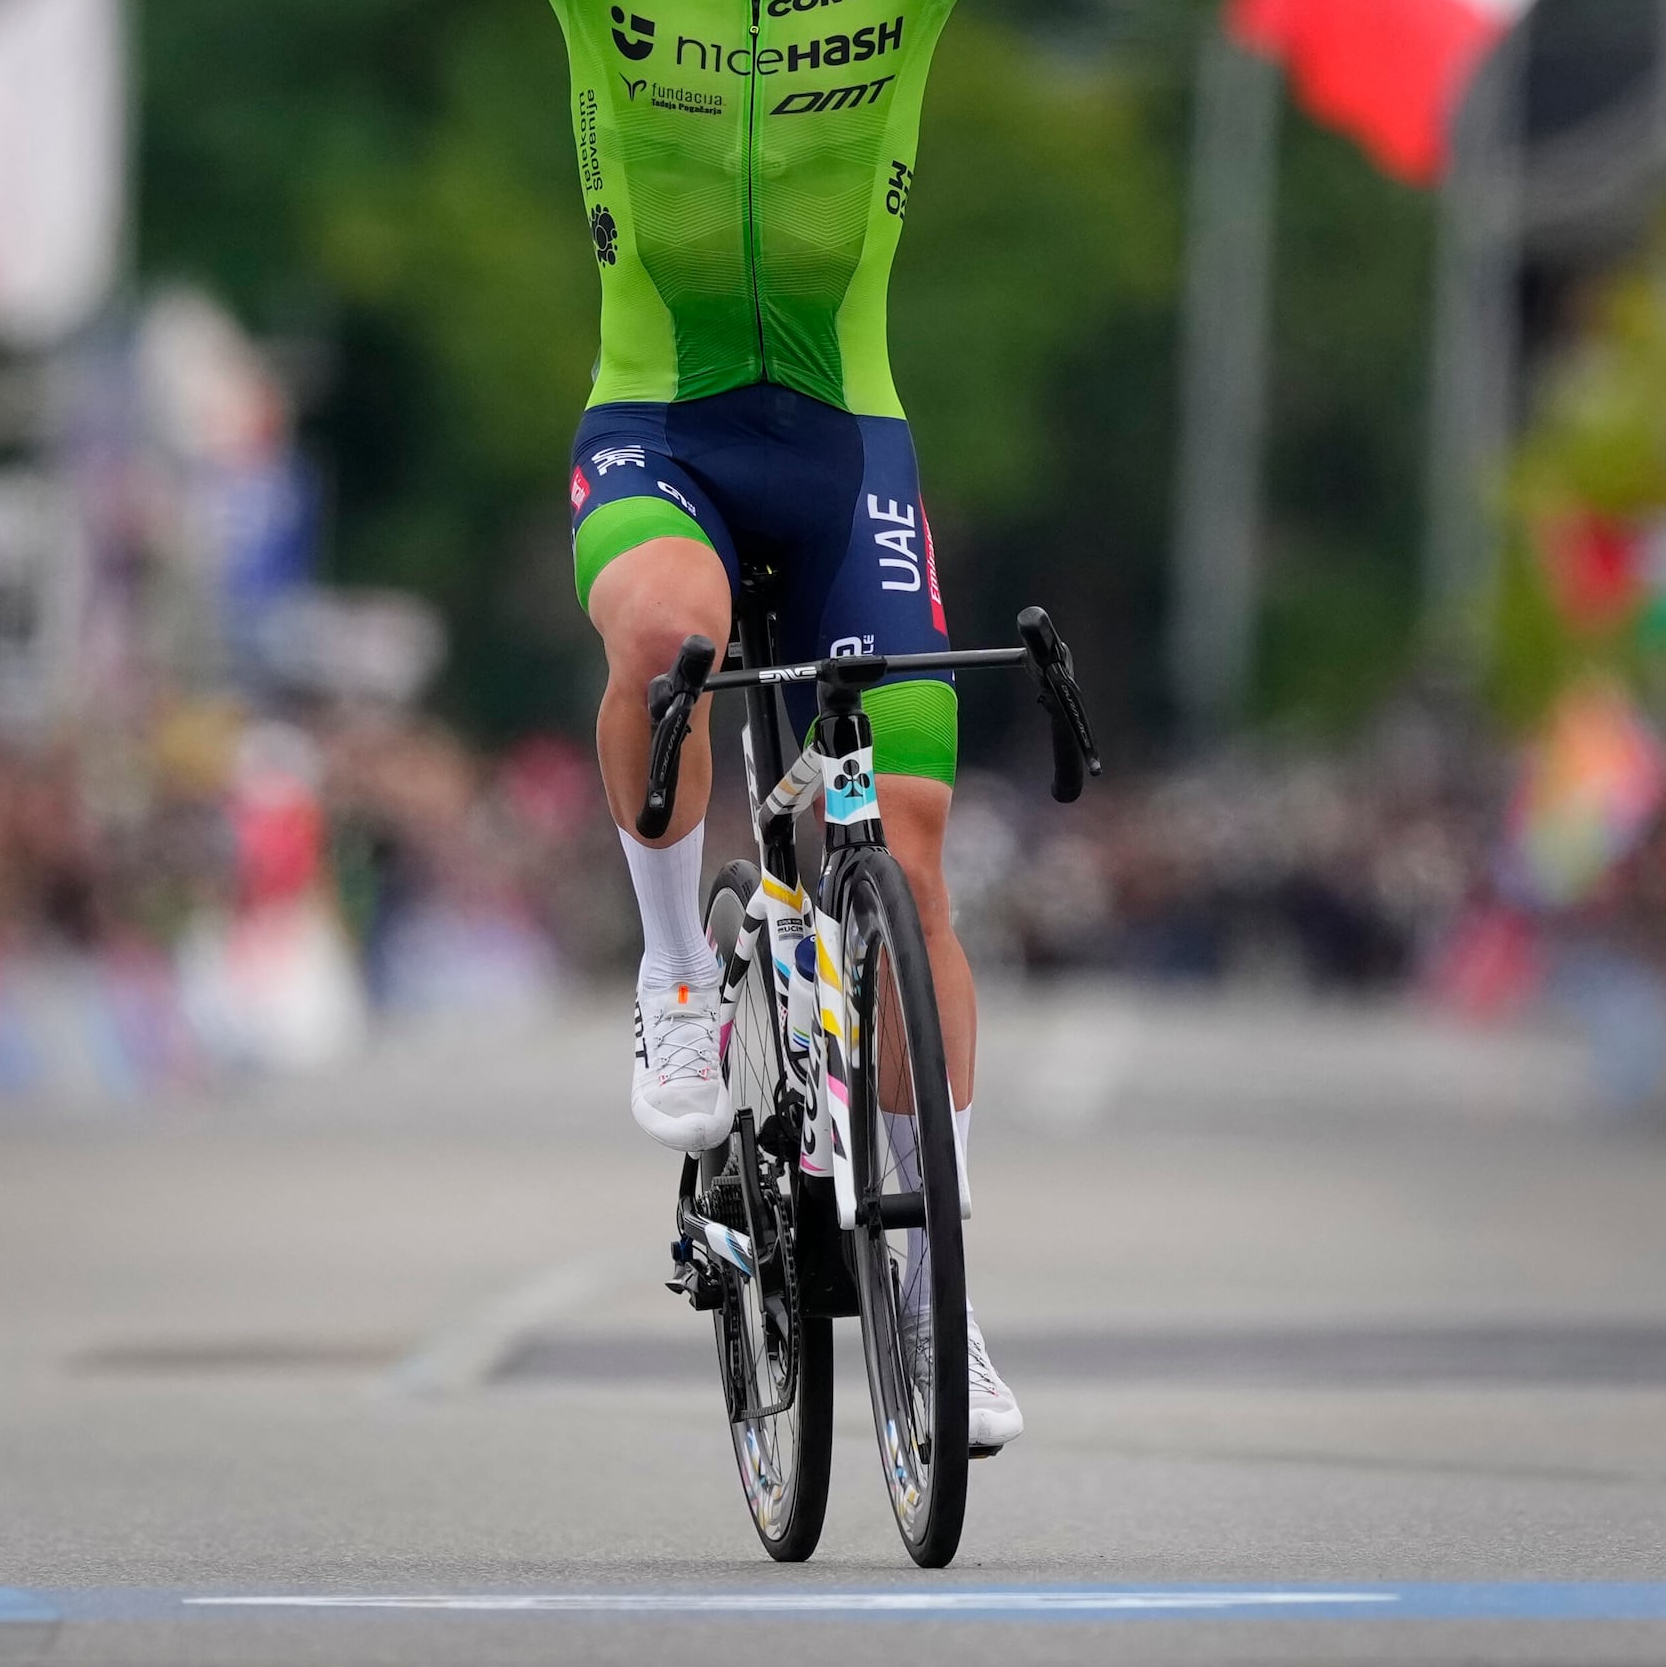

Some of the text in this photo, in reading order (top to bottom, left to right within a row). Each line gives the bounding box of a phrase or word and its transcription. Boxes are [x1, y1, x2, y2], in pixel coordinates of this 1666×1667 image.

[579, 92, 594, 192] Telekom
[587, 89, 603, 191] Slovenije
[770, 75, 895, 115] DMT
[867, 494, 921, 592] UAE
